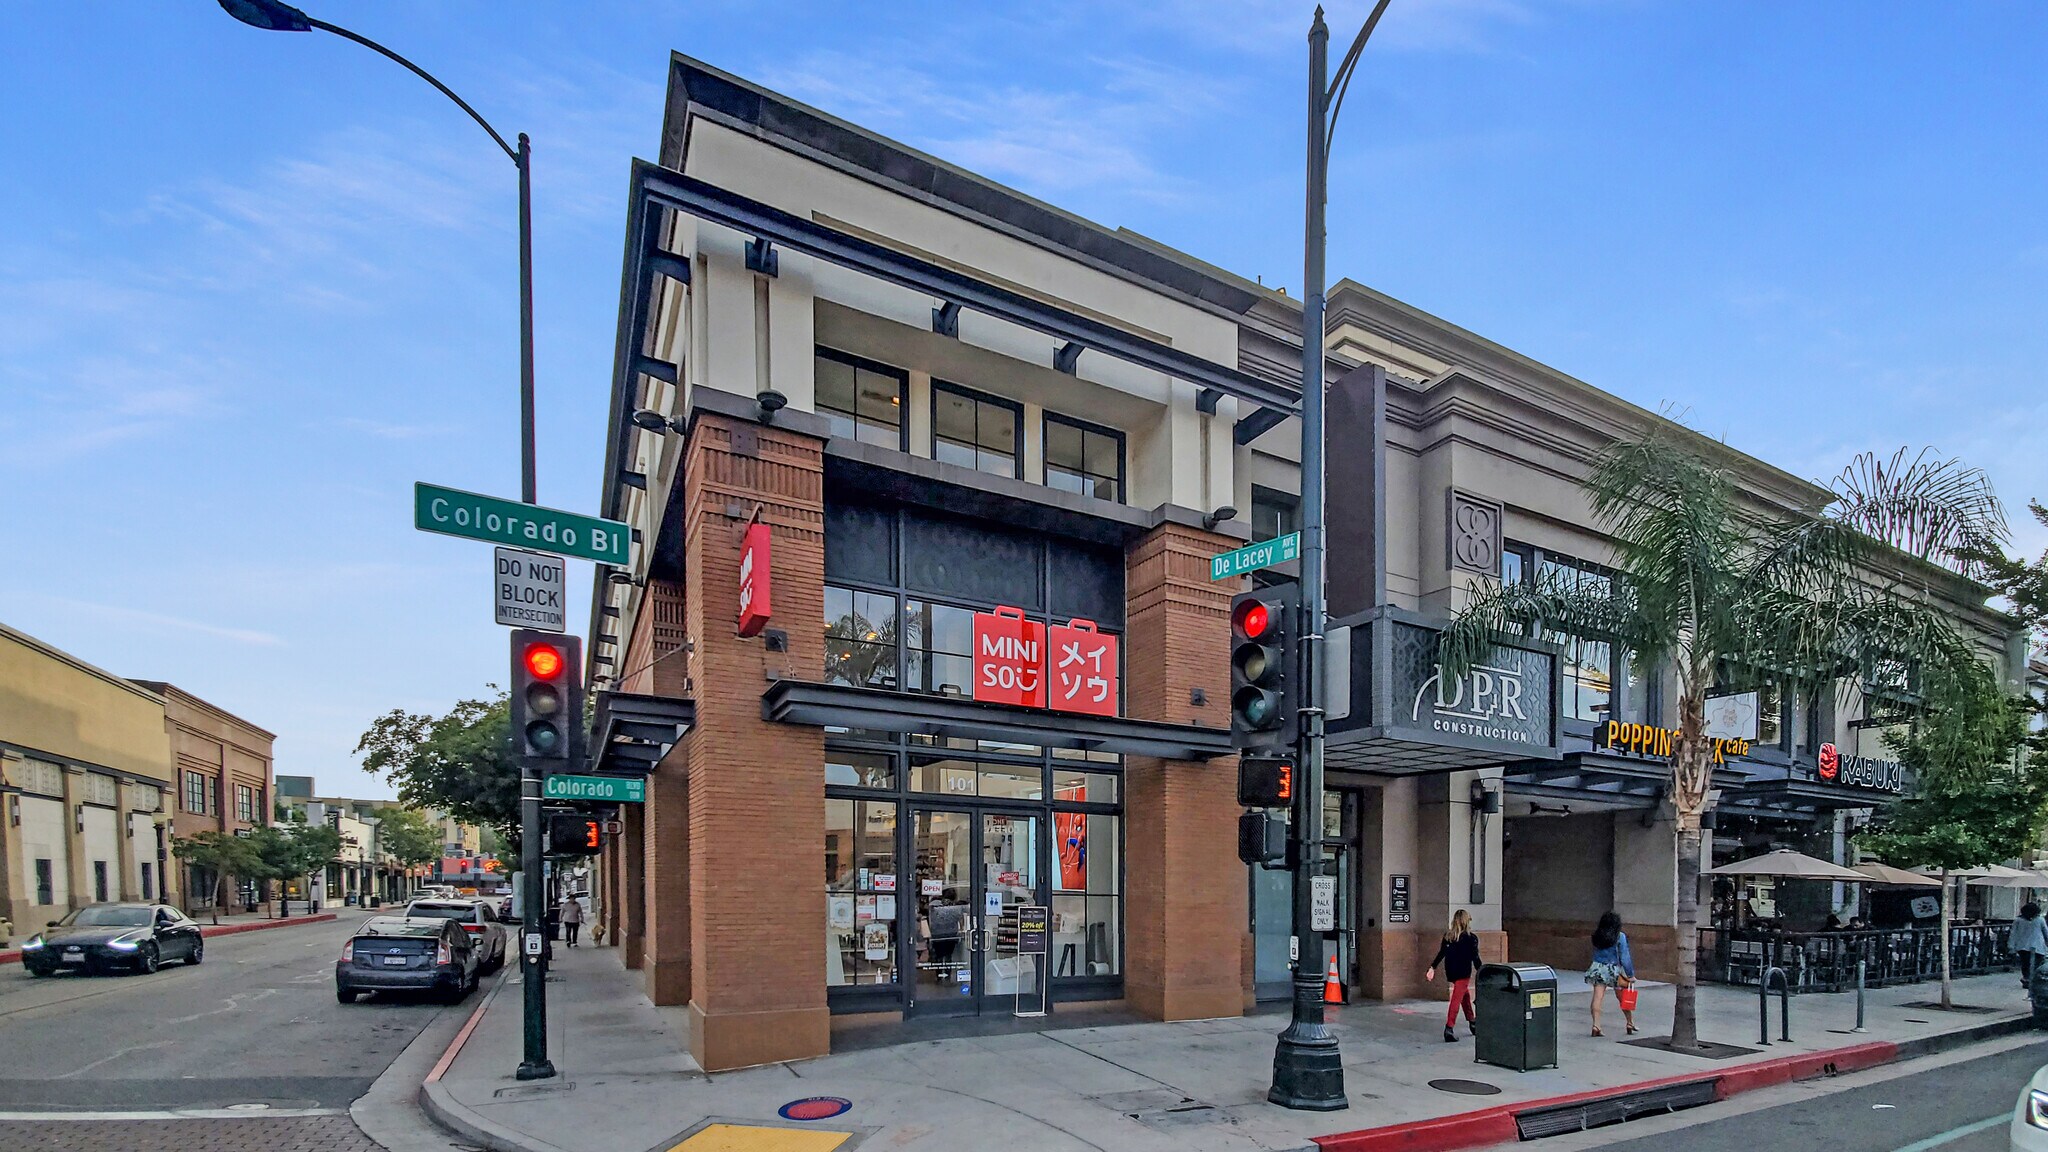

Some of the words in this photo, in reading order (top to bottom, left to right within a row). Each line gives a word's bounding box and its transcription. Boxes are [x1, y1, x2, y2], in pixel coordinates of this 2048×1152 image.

[431, 497, 577, 546] Colorado
[591, 528, 618, 554] Bl
[1282, 536, 1295, 549] AVE
[499, 557, 522, 577] DO
[529, 562, 562, 584] NOT
[1215, 557, 1230, 576] De
[1235, 546, 1273, 570] Lacey
[502, 584, 559, 608] BLOCK
[498, 605, 562, 625] INTERSECTION
[982, 633, 1038, 663] MINI
[1058, 641, 1107, 673] メイ
[1060, 672, 1108, 703] ソウ
[1434, 719, 1527, 742] CONSTRUCTION
[1607, 719, 1681, 757] POPPIN
[1726, 737, 1749, 756] cafe
[1841, 753, 1901, 791] KABUKI
[547, 777, 613, 797] Colorado
[948, 776, 974, 792] 101
[923, 885, 941, 893] OPEN
[1315, 882, 1331, 890] CROSS
[1316, 899, 1330, 907] WALK
[1316, 917, 1329, 925] ONLY
